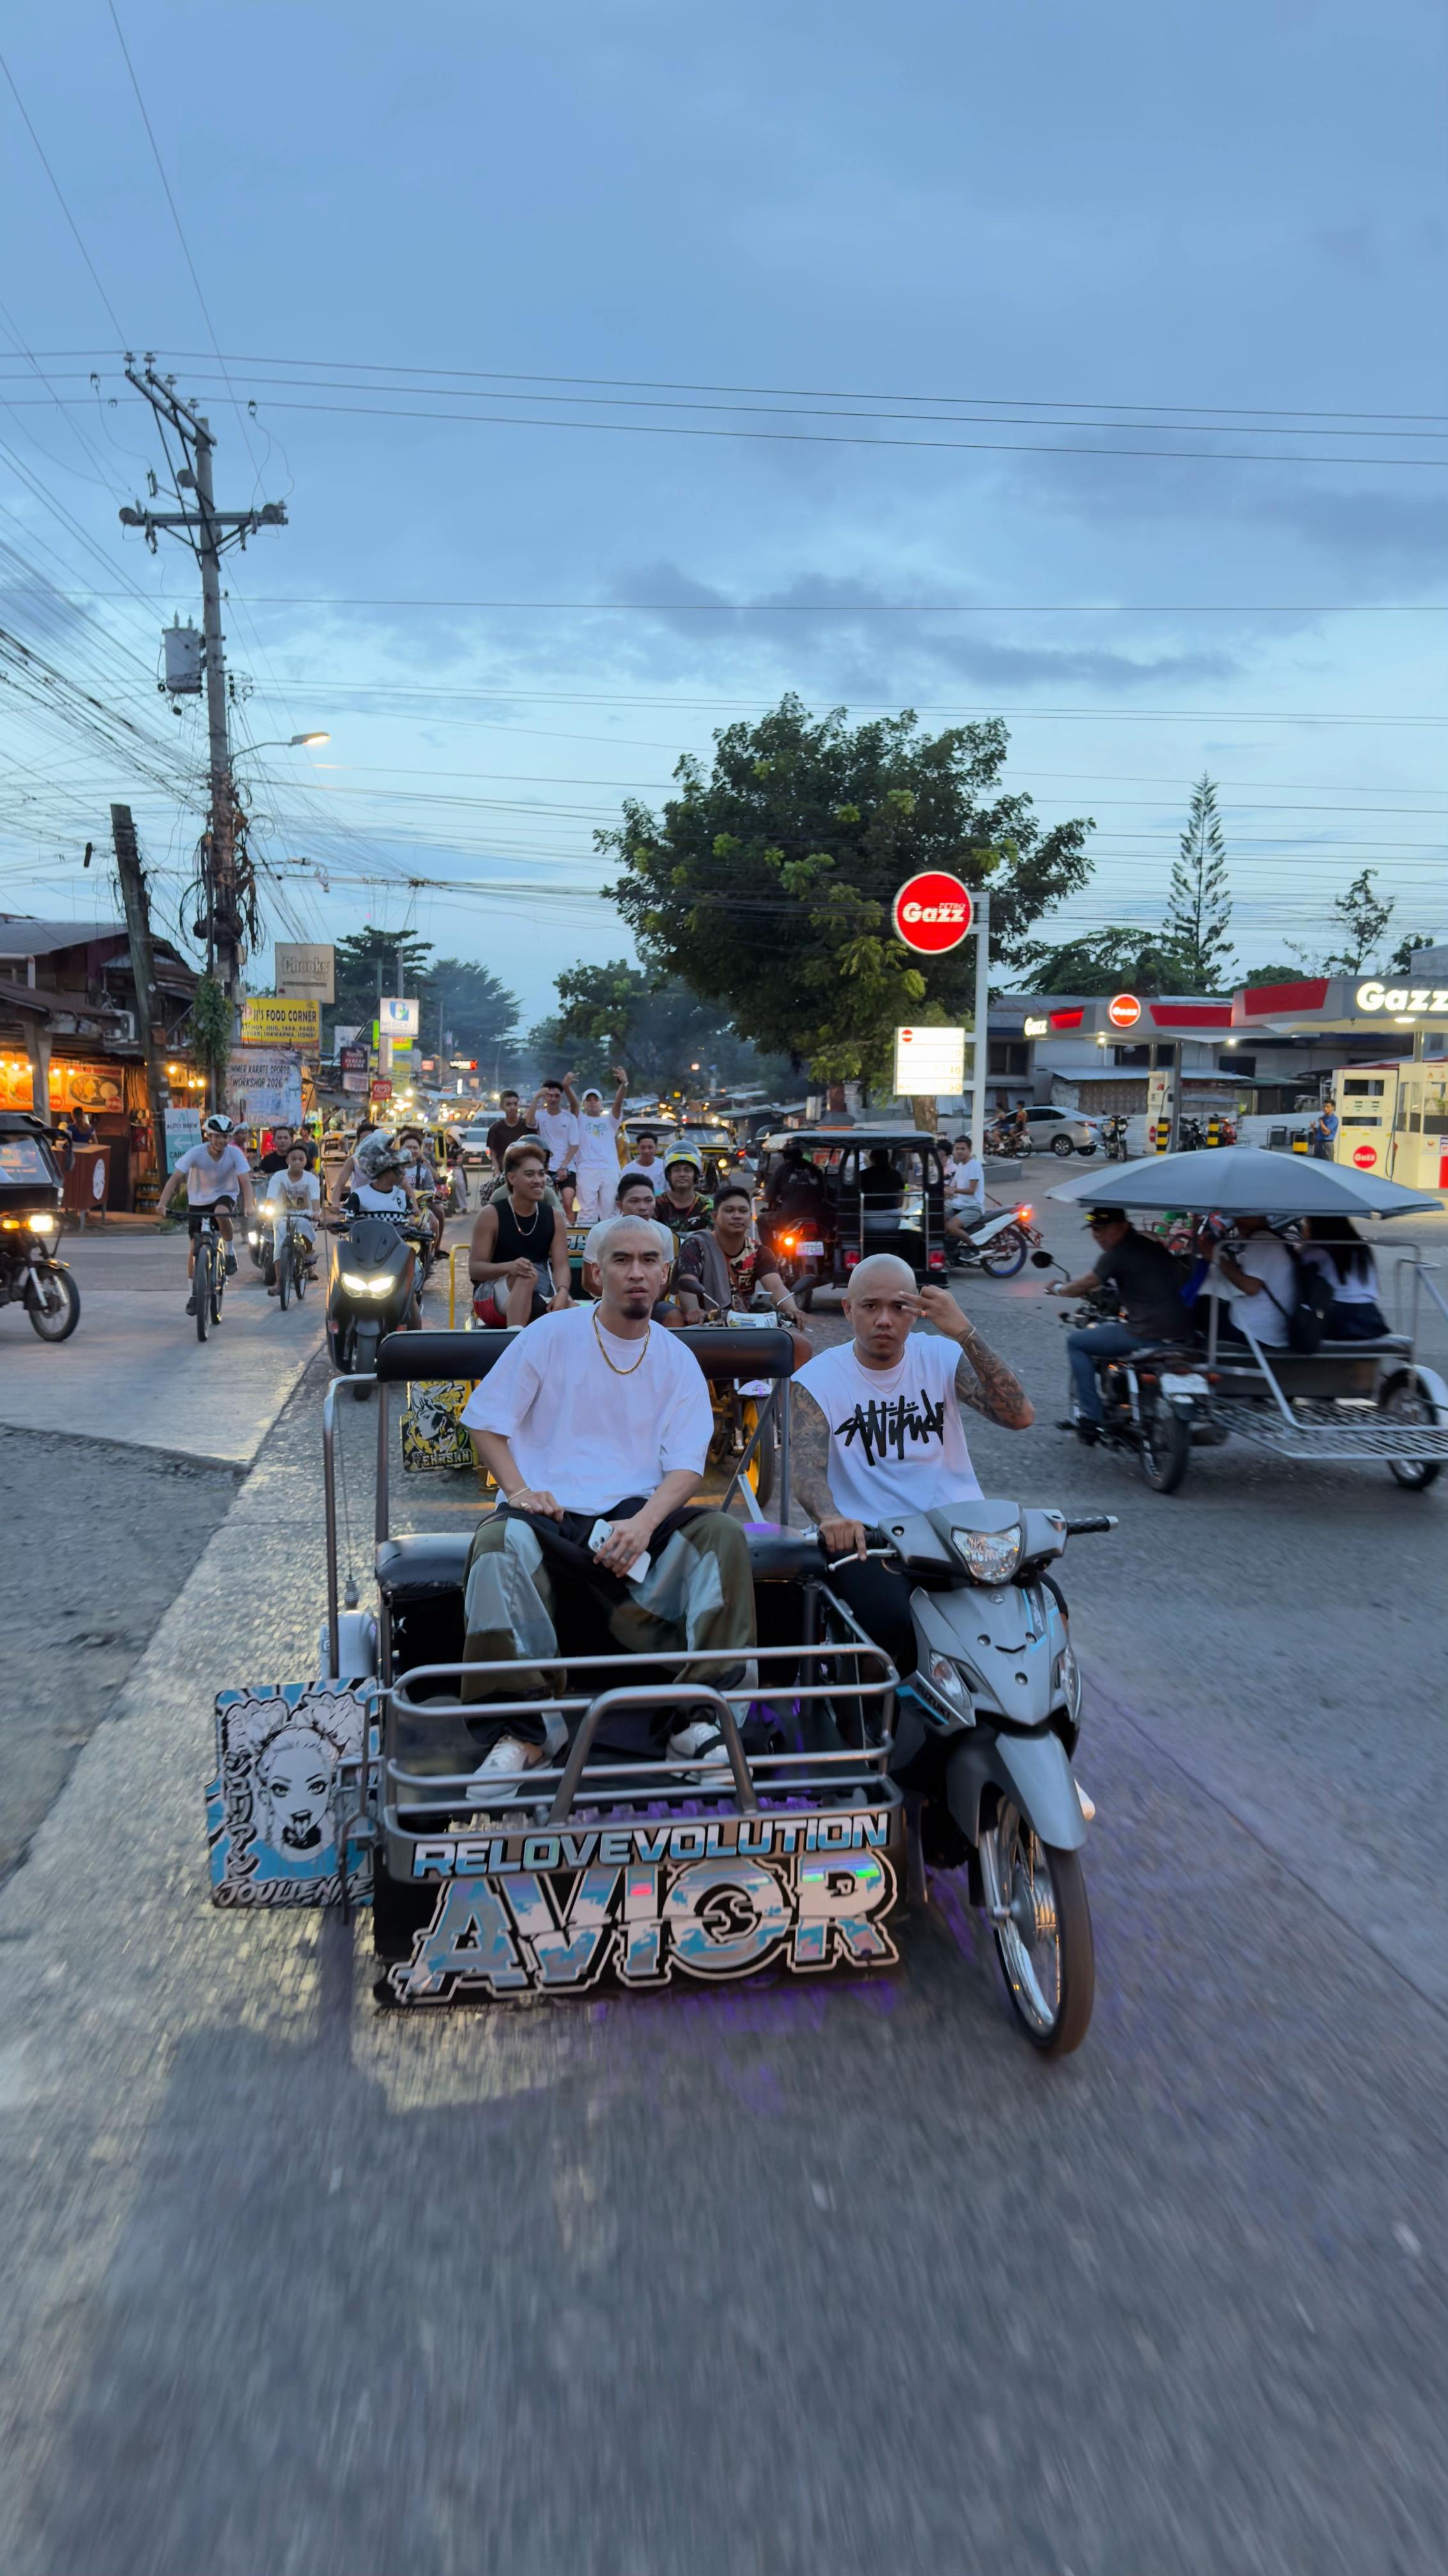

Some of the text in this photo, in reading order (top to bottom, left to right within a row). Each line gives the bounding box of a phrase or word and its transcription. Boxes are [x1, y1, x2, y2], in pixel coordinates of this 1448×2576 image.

[902, 902, 965, 923] Gazz
[1357, 982, 1448, 1011] Gazz
[266, 1010, 286, 1021] FOOD
[288, 1011, 316, 1023] CORNER
[248, 1065, 268, 1074] KARATE
[233, 1078, 282, 1087] WORKSHOP 2026
[413, 1813, 891, 1878] RELOVEVOLUTION
[387, 1849, 899, 2004] AVIOR
